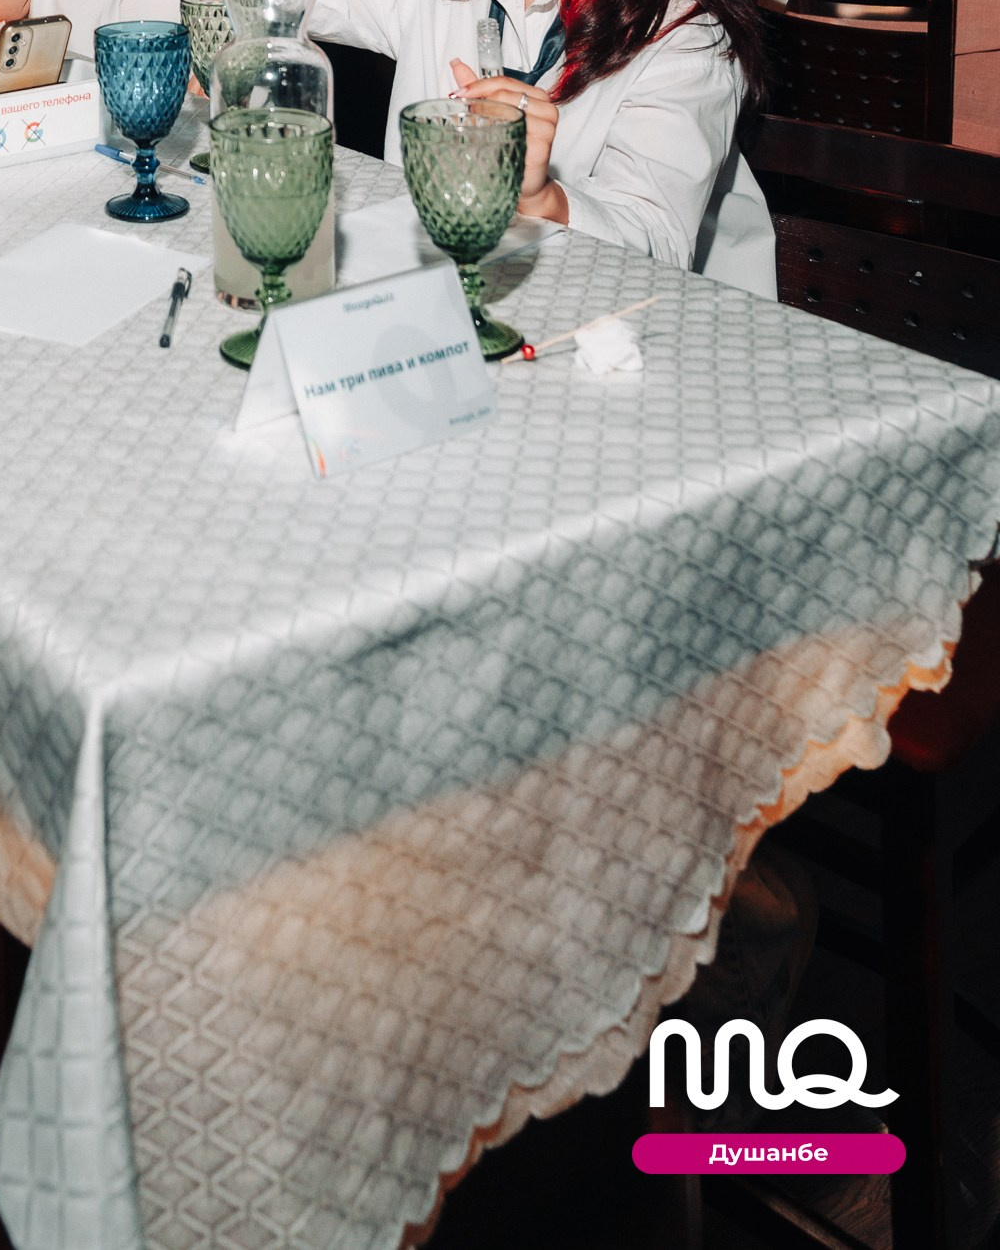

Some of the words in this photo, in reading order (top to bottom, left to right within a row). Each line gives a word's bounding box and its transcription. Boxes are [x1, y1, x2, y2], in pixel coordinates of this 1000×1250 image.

[1, 101, 40, 116] вашего
[43, 91, 92, 108] телефона
[304, 380, 337, 399] Нам
[340, 373, 365, 391] три
[368, 361, 405, 382] пива
[406, 355, 416, 368] и
[419, 341, 470, 367] компот
